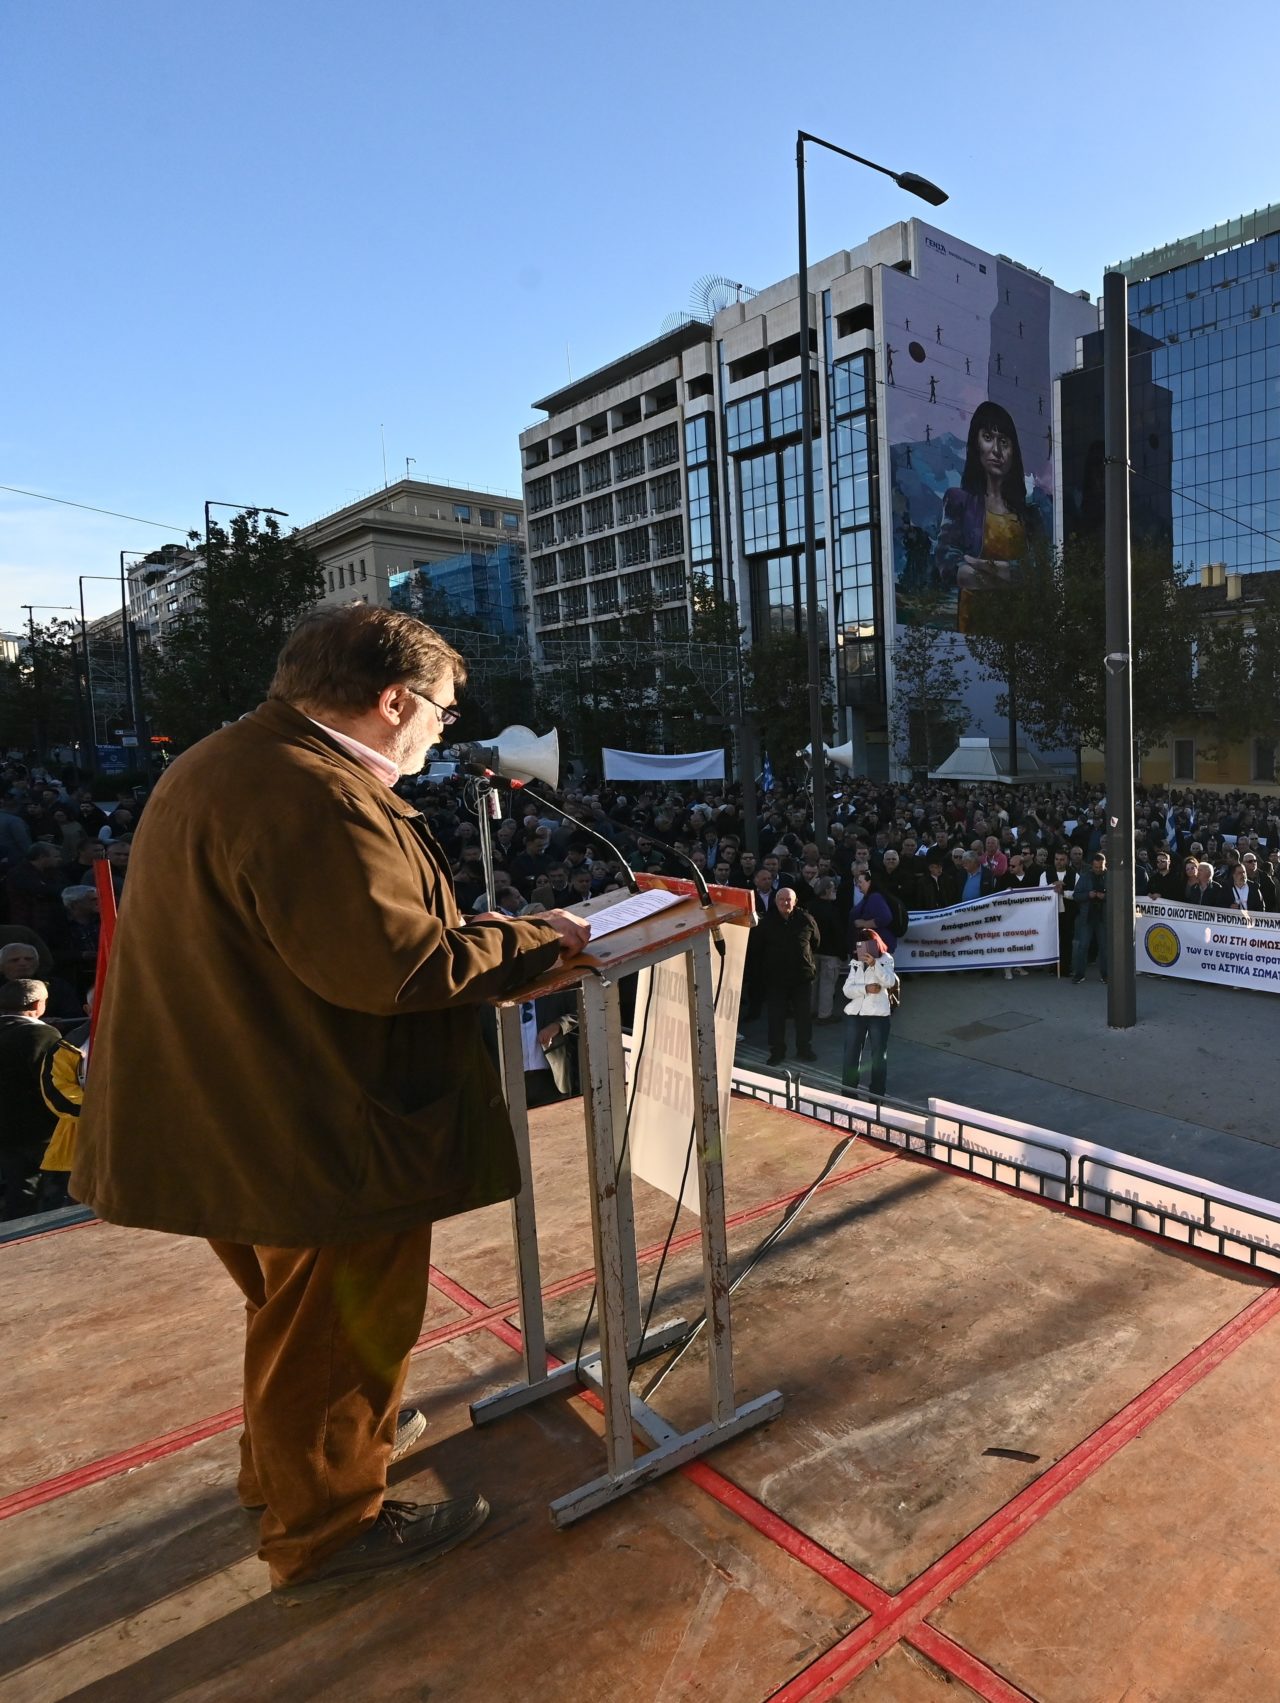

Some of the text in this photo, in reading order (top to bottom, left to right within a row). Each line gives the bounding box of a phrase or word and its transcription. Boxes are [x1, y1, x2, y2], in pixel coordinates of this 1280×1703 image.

[1135, 903, 1165, 917] ΩΜΑΤΕΙΟ
[1167, 907, 1215, 922] ΟΙΚΟΓΕΝΕΙΩΝ
[1216, 914, 1253, 927] ΕΝΟΠΛΩΝ
[1213, 934, 1228, 944] ΟΧΙ
[1230, 936, 1247, 947] ΣΤΗ
[986, 945, 1004, 954] είναι
[1186, 946, 1202, 955] των
[1203, 949, 1213, 957] εν
[1215, 950, 1253, 963] ενεργεία
[1200, 963, 1216, 971] στα
[1218, 964, 1250, 976] ΑΣΤΙΚΑ
